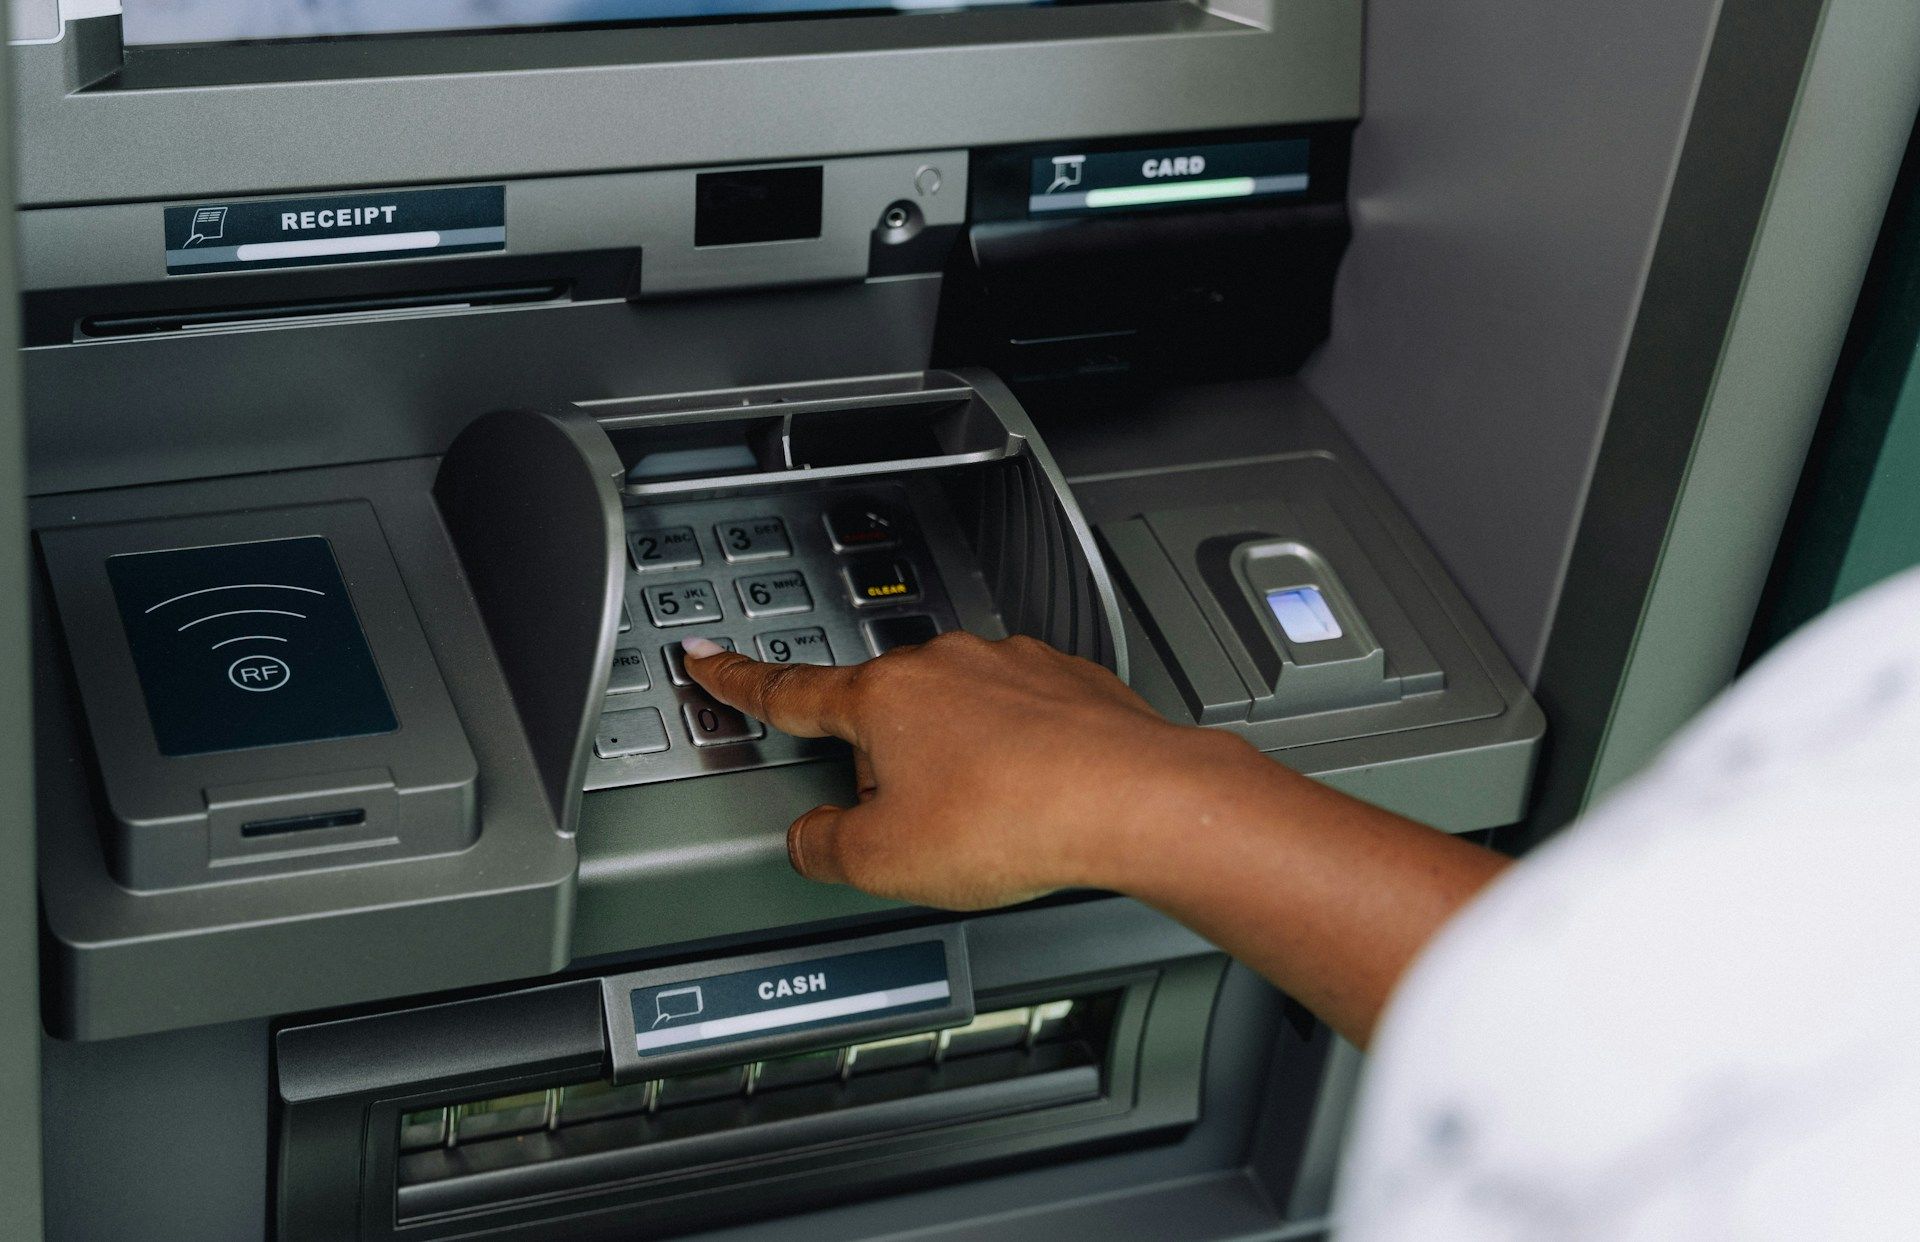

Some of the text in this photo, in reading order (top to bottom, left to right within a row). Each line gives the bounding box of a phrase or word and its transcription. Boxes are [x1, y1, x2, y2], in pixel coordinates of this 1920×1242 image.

[1141, 155, 1206, 179] CARD
[281, 205, 397, 231] RECEIPT
[638, 533, 691, 560] 2 ABC
[729, 527, 751, 550] 3
[659, 588, 708, 615] 5 JKL
[749, 583, 771, 605] 6
[867, 583, 908, 597] CLEAR
[769, 639, 791, 662] 9
[240, 665, 278, 682] RF
[698, 708, 719, 732] 0
[758, 972, 827, 1000] CASH
